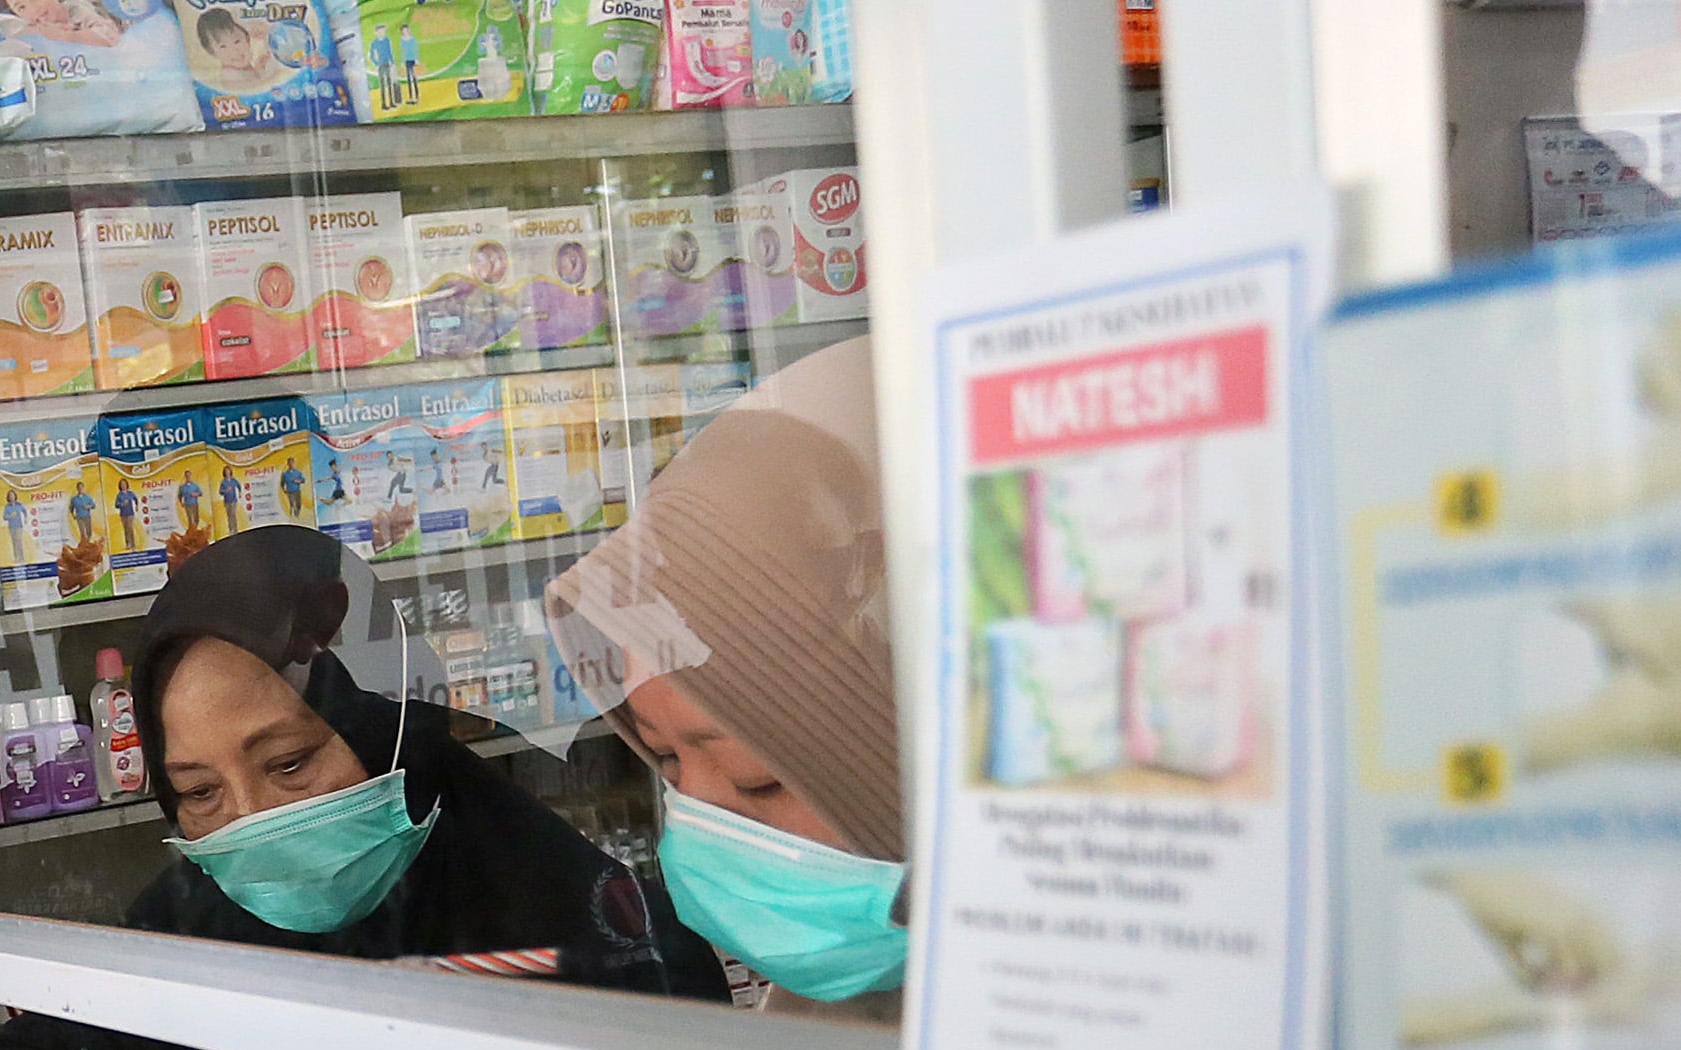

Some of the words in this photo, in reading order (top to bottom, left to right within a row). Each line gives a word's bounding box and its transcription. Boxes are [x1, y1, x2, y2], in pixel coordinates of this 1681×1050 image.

[267, 4, 307, 22] Dry
[701, 8, 732, 19] Mama
[61, 54, 87, 79] 24
[214, 97, 250, 119] XXL
[253, 102, 274, 122] 16
[816, 179, 858, 214] SGM
[208, 214, 280, 237] PEPTISOL
[309, 210, 379, 232] PEPTISOL
[514, 217, 583, 238] NEPHRISOL
[628, 207, 694, 228] NEPHRISOL
[96, 221, 175, 243] ENTRAMIX
[1011, 349, 1220, 444] NATESH
[214, 407, 298, 439] Entrasol
[318, 396, 400, 427] Entrasol
[108, 419, 194, 451] Entrasol
[131, 464, 151, 475] Gold
